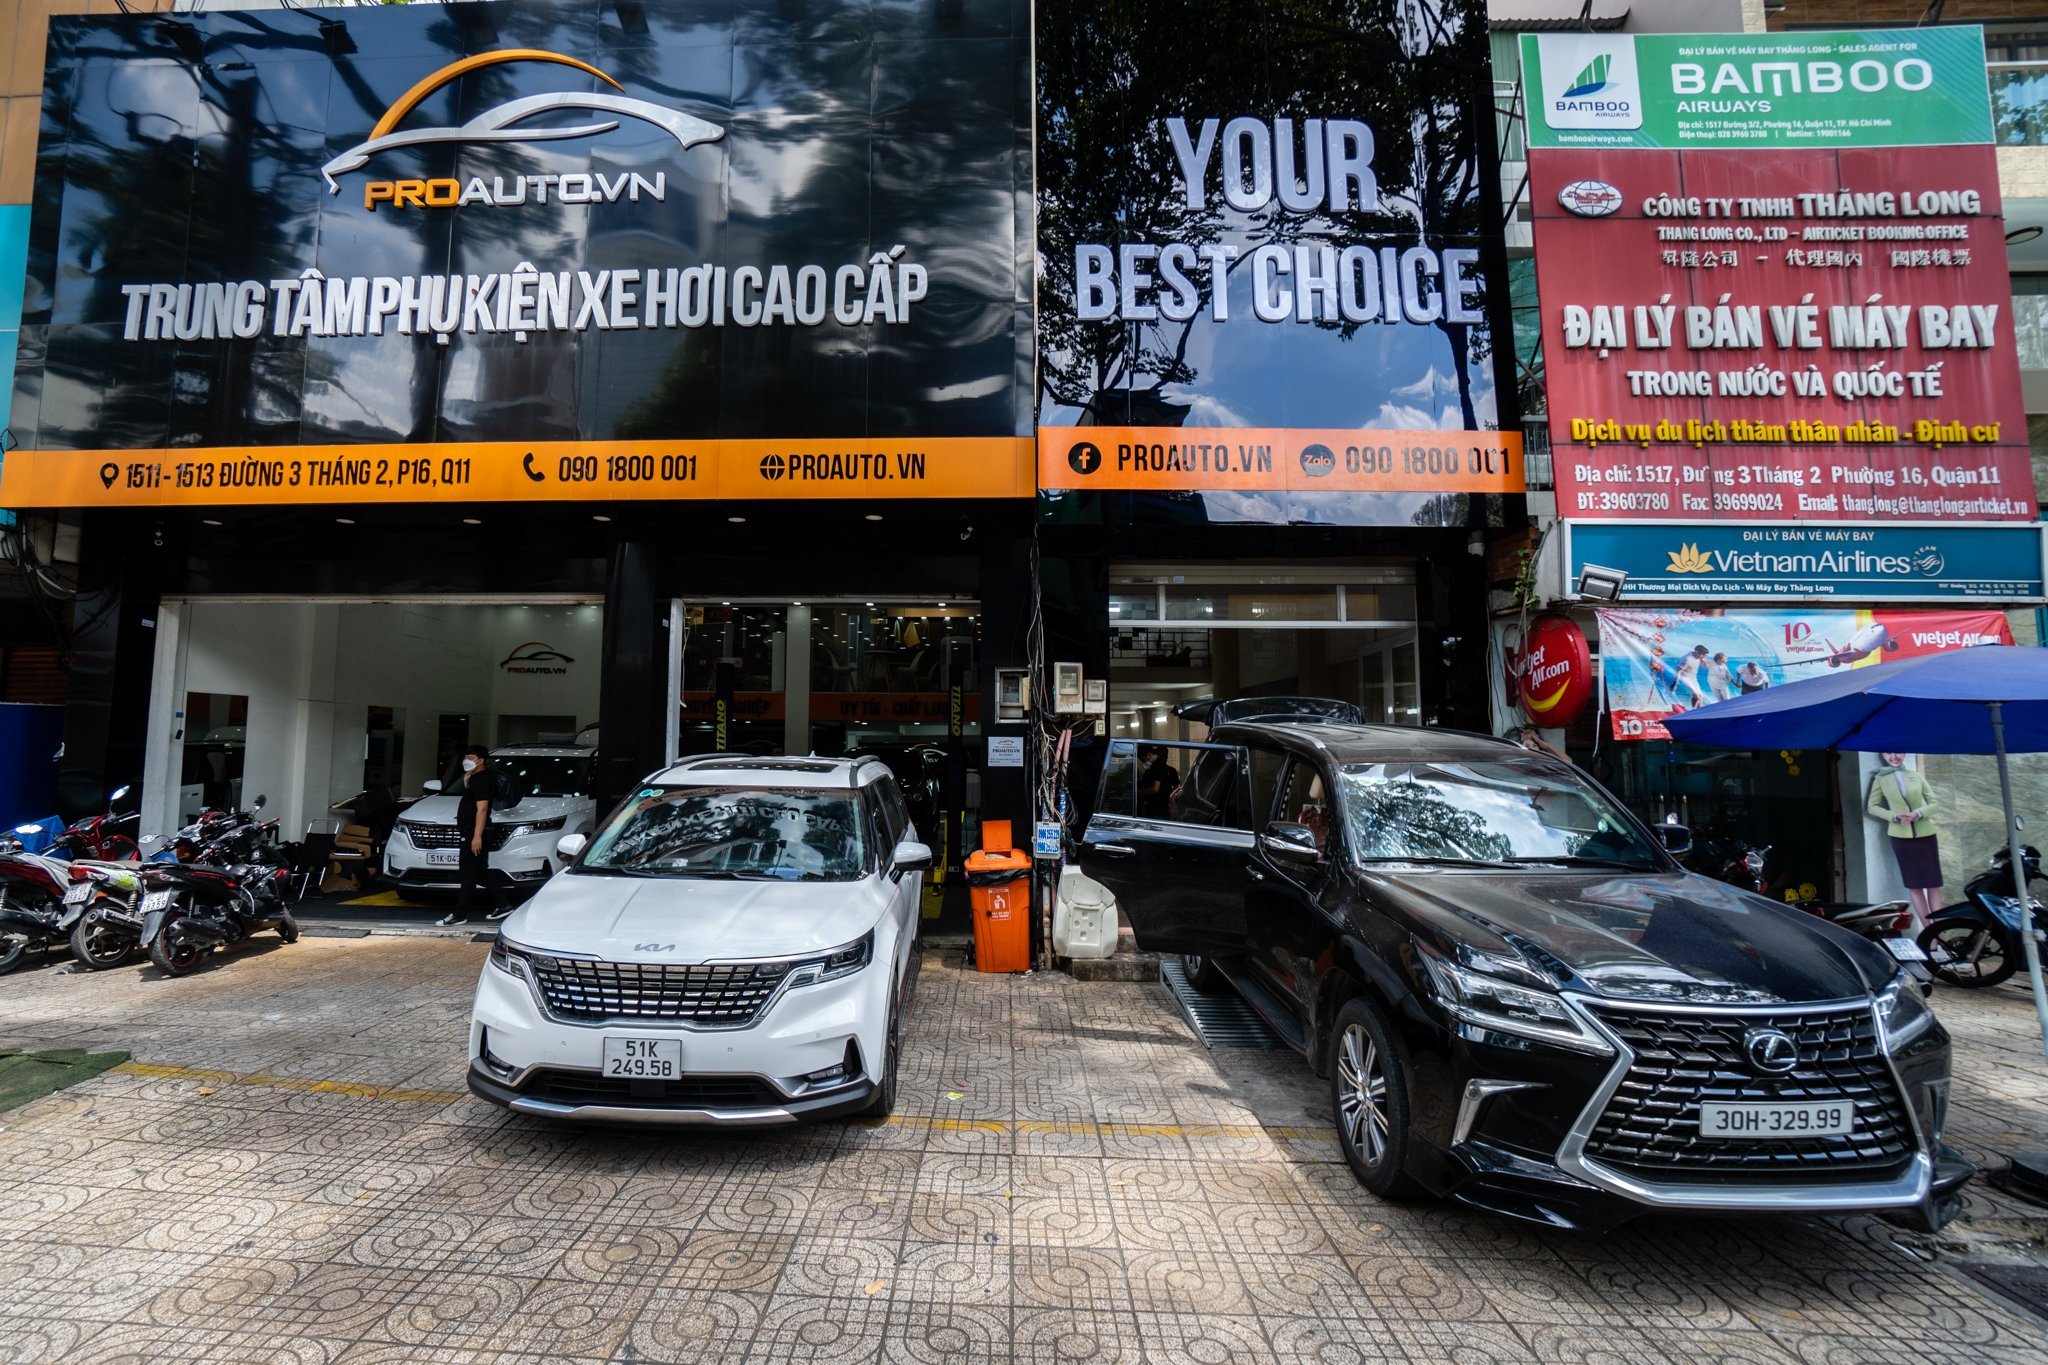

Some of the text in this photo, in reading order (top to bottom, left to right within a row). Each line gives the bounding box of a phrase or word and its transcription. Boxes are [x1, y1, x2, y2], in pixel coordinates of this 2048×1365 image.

[1678, 47, 1694, 56] ĐẠI
[1695, 46, 1704, 55] LÝ
[1706, 45, 1724, 55] BÁN
[1738, 45, 1757, 55] MÁY
[1758, 46, 1774, 54] BAY
[1776, 44, 1806, 55] THĂNG
[1807, 46, 1831, 54] LONG
[1838, 44, 1867, 53] SALES
[1868, 43, 1898, 52] AGENT
[1899, 42, 1918, 51] FOR
[1671, 58, 1933, 97] BAMBOO
[1556, 101, 1630, 112] BAMBOO
[1677, 100, 1771, 113] AIRWAYS
[1678, 121, 1690, 129] Địa
[1718, 130, 1730, 138] 028
[1732, 130, 1749, 138] 3960
[1558, 135, 1633, 144] bambooairways.com
[1166, 116, 1378, 213] YOUR
[364, 171, 665, 210] PROAUTO.VN
[1642, 188, 1981, 218] CÔNG TY TNHH THĂNG LONG
[1657, 224, 1968, 242] THANG LONG CO., LTD AIRTICKET BOOKING OFFICE
[122, 244, 928, 345] TRUNG TÂM PHỤ KIỆN XE HƠI CAO CẤP
[1075, 243, 1484, 324] BEST CHOICE
[1563, 293, 1999, 358] ĐẠI LÝ BÁN VÉ MÁY BAY
[1626, 361, 1944, 400] TRONG NƯỚC VÀ QUỐC TẾ
[1571, 418, 1621, 448] Dịch
[1624, 425, 1652, 448] vụ
[1655, 419, 1682, 441] du
[1686, 419, 1727, 449] lịch
[1730, 419, 1786, 442] thăm
[1790, 420, 1839, 442] thân
[1843, 420, 1899, 442] nhân
[1914, 419, 1968, 450] Định
[1970, 421, 2000, 442] cư
[558, 454, 696, 482] 090 1800 001
[1119, 445, 1272, 472] PROAUTO.VN
[1305, 454, 1330, 466] Zalo
[1346, 446, 1510, 474] 090 1800 001
[126, 455, 470, 489] 1511 1513 ĐƯỜNG 3 THÁNG 2, P16, Q11
[1575, 464, 1601, 486] Địa
[1605, 463, 1632, 482] chỉ:
[1737, 465, 1751, 483] 3
[1752, 464, 1804, 487] Tháng
[1810, 466, 1822, 484] 2
[1831, 466, 1895, 487] Phường
[1901, 466, 1928, 487] 16,
[1931, 465, 1978, 488] Quận
[1979, 466, 2000, 484] 11
[1713, 494, 1783, 511] 39699024
[1742, 529, 1875, 543] ĐẠI LÝ BÁN VÉ MÁY BAY
[1638, 583, 1666, 592] Thương
[1667, 583, 1681, 592] Mại
[1700, 584, 1711, 592] Vụ
[1724, 584, 1740, 592] Lịch
[1756, 584, 1772, 592] Máy
[1774, 584, 1788, 592] Bay
[1790, 584, 1813, 593] Thăng
[1815, 584, 1834, 593] Long
[1782, 622, 1812, 645] 10
[952, 685, 961, 737] TITANO
[716, 700, 726, 750] TITANO
[1620, 720, 1642, 736] 10
[626, 1041, 658, 1058] 51K
[612, 1058, 672, 1076] 249.58
[1716, 1109, 1841, 1130] 30H-329.99
